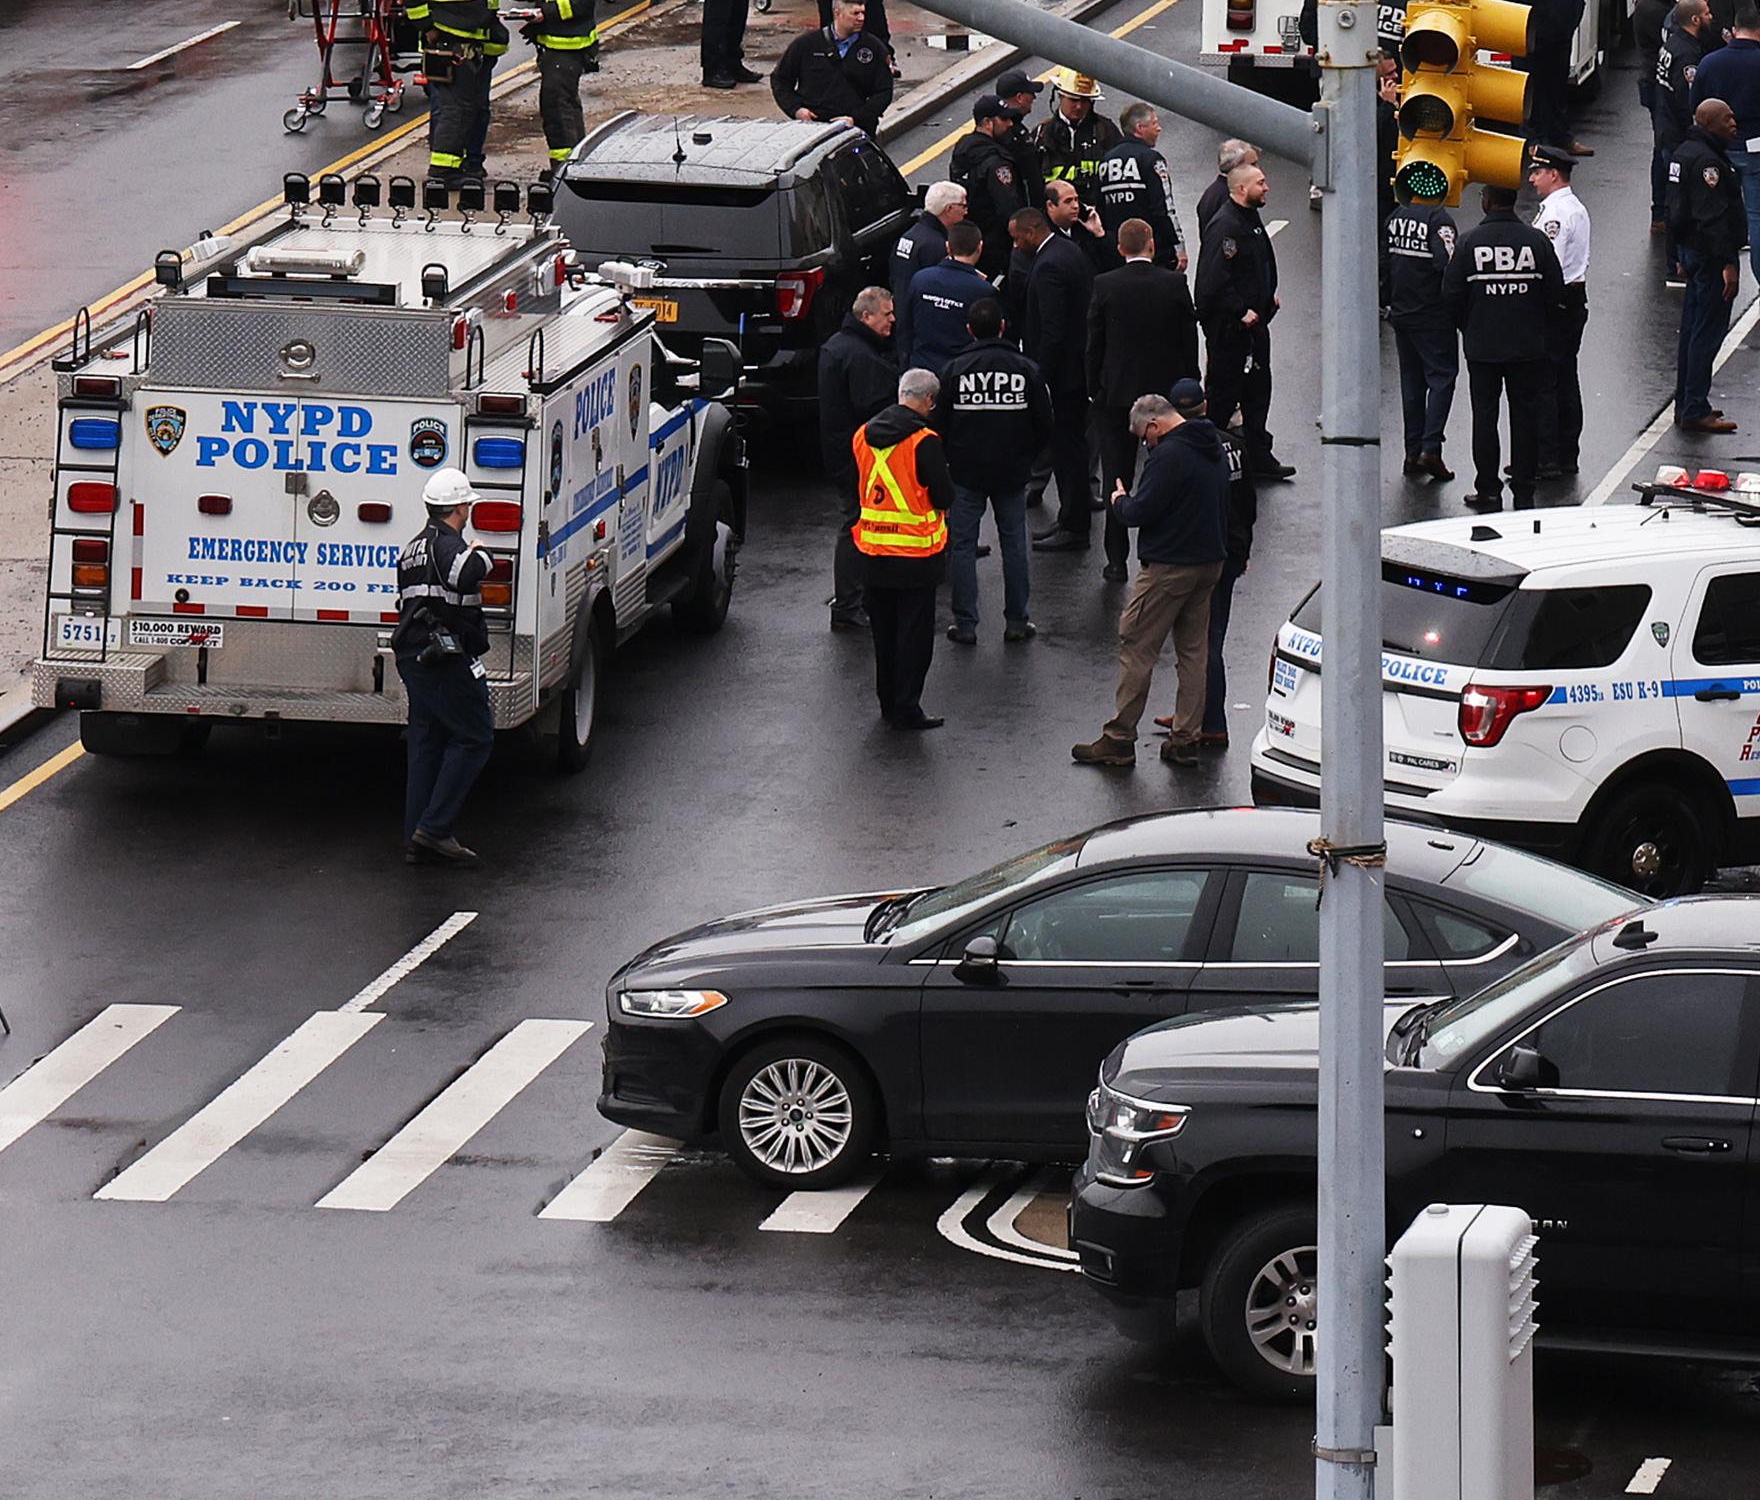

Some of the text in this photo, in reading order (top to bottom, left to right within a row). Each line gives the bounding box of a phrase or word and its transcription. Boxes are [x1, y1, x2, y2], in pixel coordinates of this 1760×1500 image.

[1388, 218, 1428, 240] NYPD
[1473, 245, 1536, 272] PBA
[1485, 282, 1528, 296] NYPD
[959, 371, 1026, 392] NYPD
[574, 367, 616, 441] POLICE
[959, 391, 1026, 406] POLICE
[221, 401, 373, 438] NYPD
[411, 419, 446, 434] POLICE
[196, 436, 398, 476] POLICE
[188, 537, 400, 570] EMERGENCY SERVICE
[166, 573, 356, 592] KEEP BACK 200
[177, 622, 222, 634] REWARD
[1569, 680, 1660, 702] 4395 ESU K-9
[1407, 756, 1440, 768] PAL CARES
